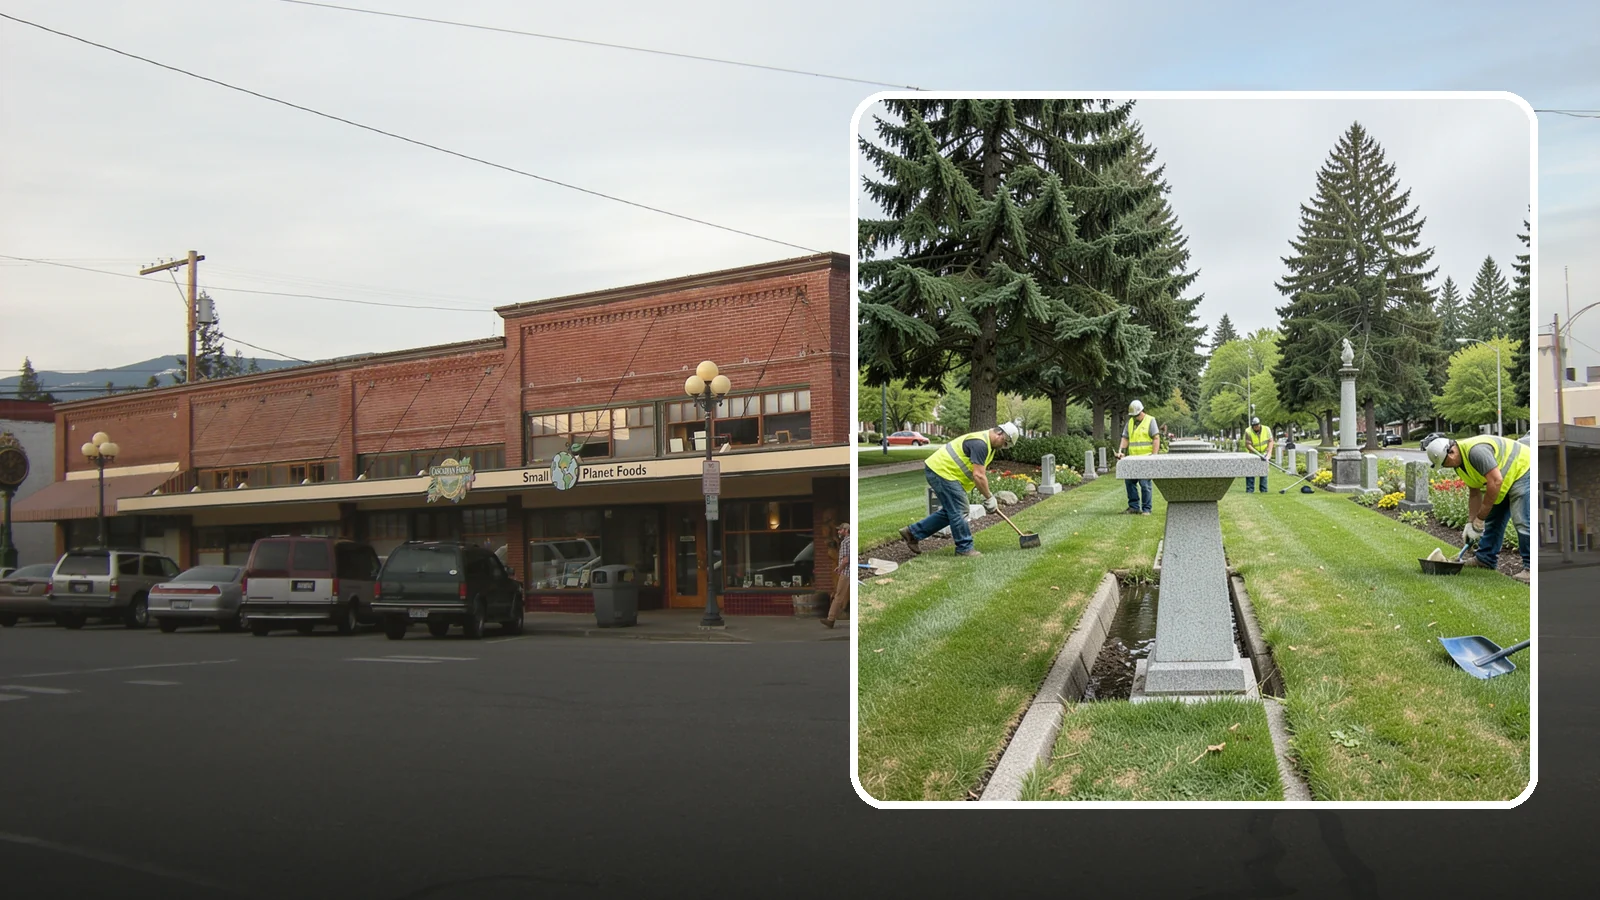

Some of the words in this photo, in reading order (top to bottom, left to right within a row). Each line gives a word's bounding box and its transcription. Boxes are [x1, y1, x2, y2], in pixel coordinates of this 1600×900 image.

[523, 471, 549, 483] Small
[582, 467, 614, 479] Planet
[617, 464, 647, 477] Foods
